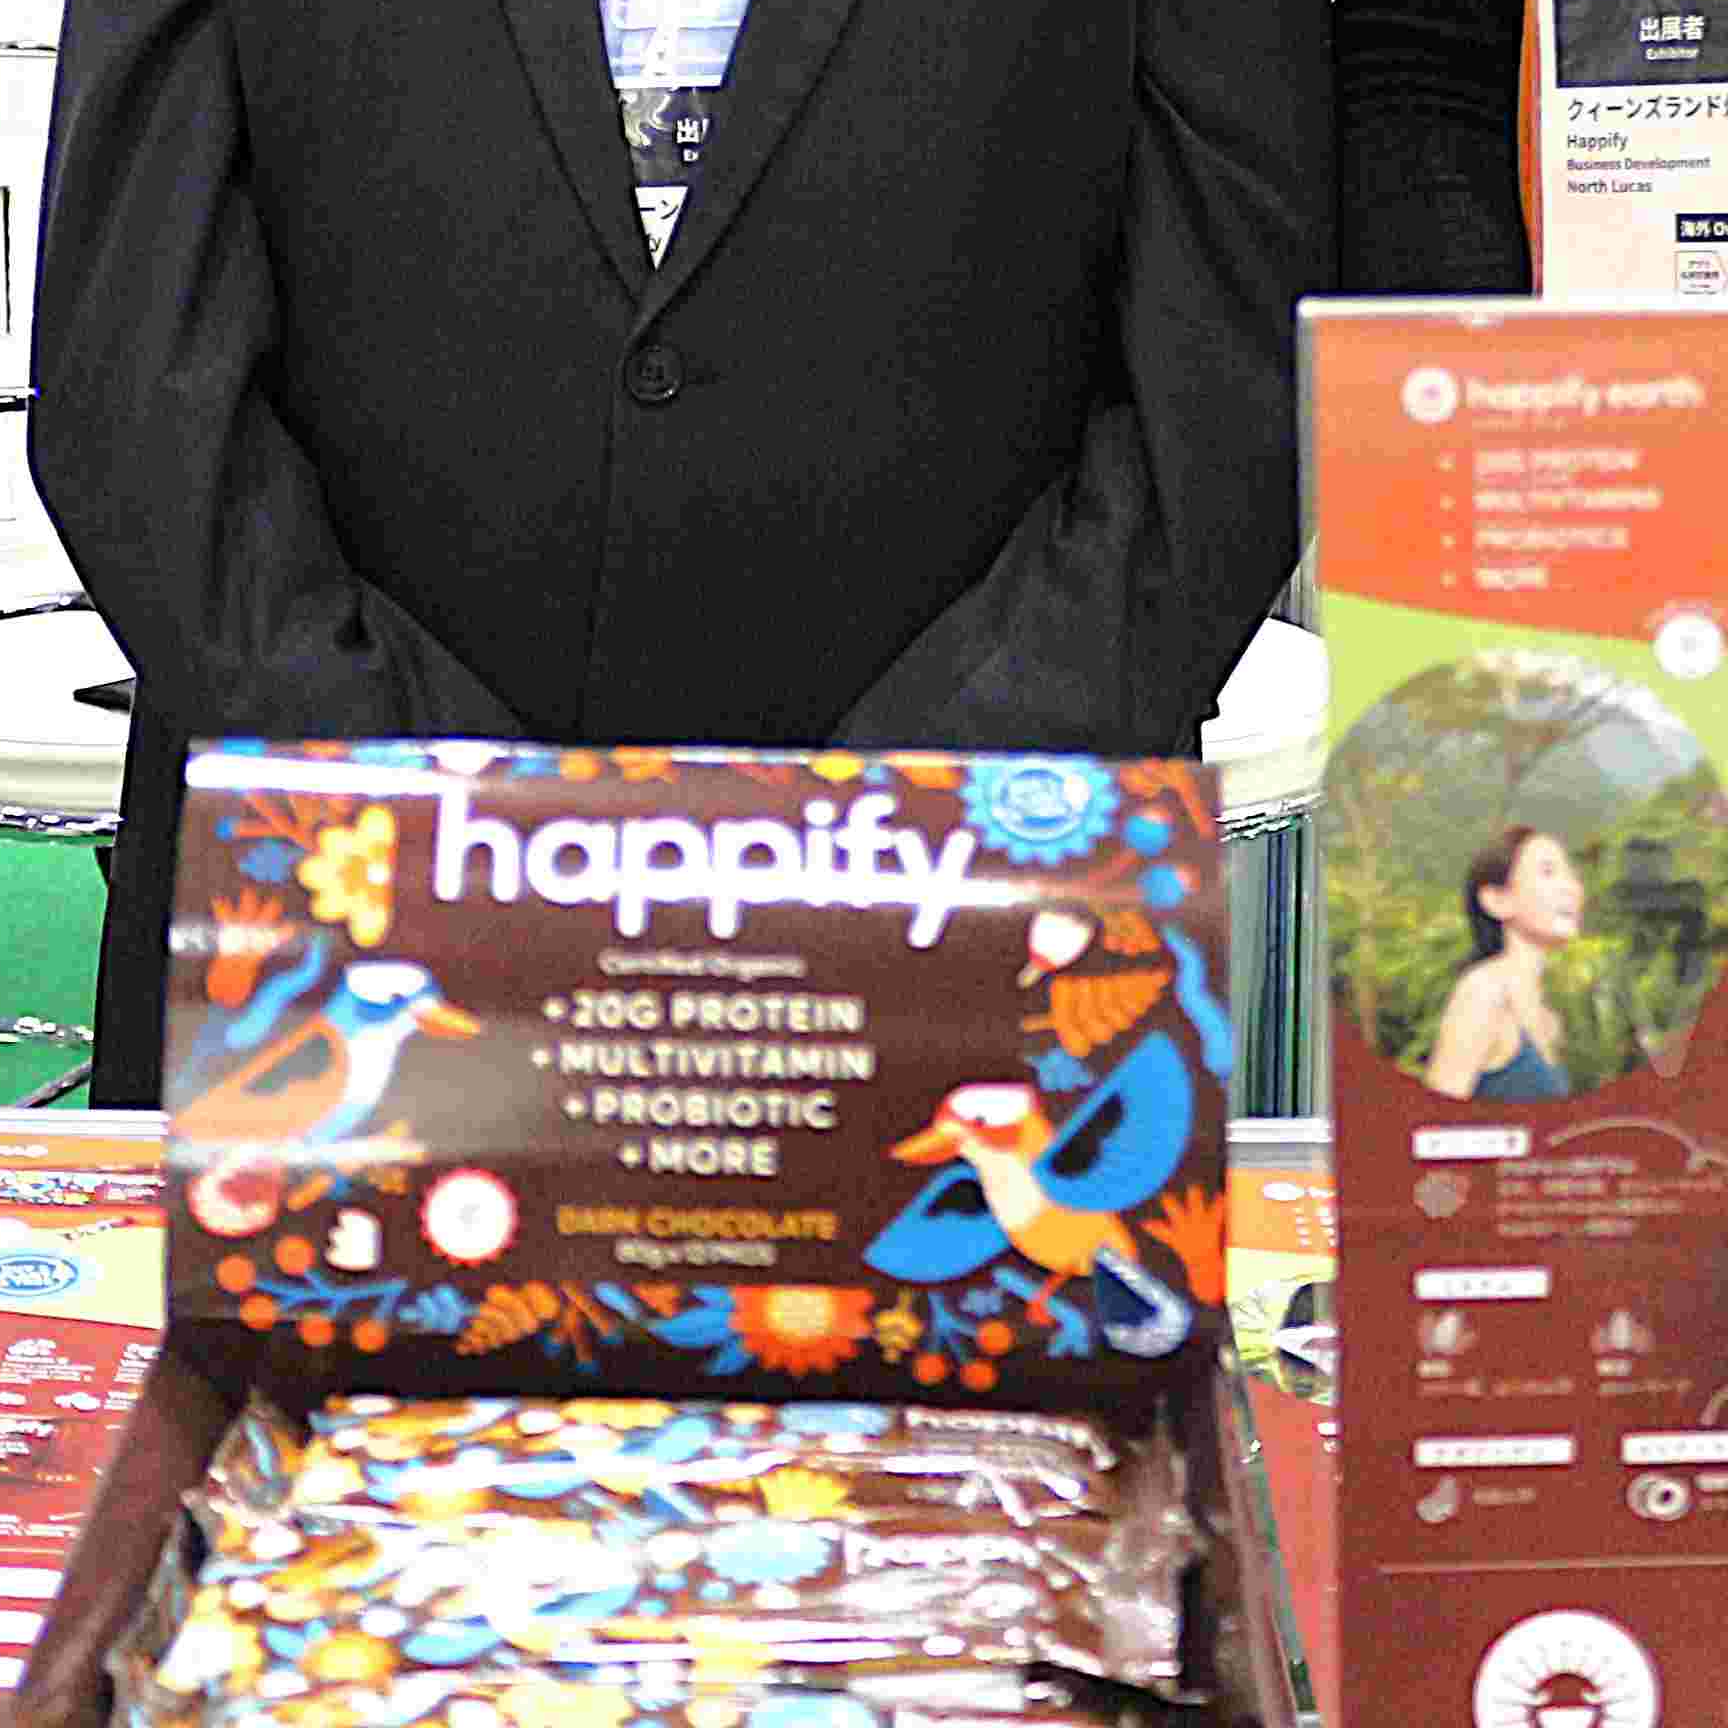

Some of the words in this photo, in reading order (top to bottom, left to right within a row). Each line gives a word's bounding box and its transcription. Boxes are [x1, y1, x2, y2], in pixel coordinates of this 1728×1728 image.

[1639, 16, 1705, 42] 出展者
[1567, 132, 1629, 151] Happify
[1567, 159, 1622, 171] Business
[1624, 157, 1711, 172] Development
[1567, 180, 1608, 193] North
[1611, 181, 1653, 193] Lucas
[432, 786, 978, 950] happify
[670, 991, 866, 1031] PROTEIN
